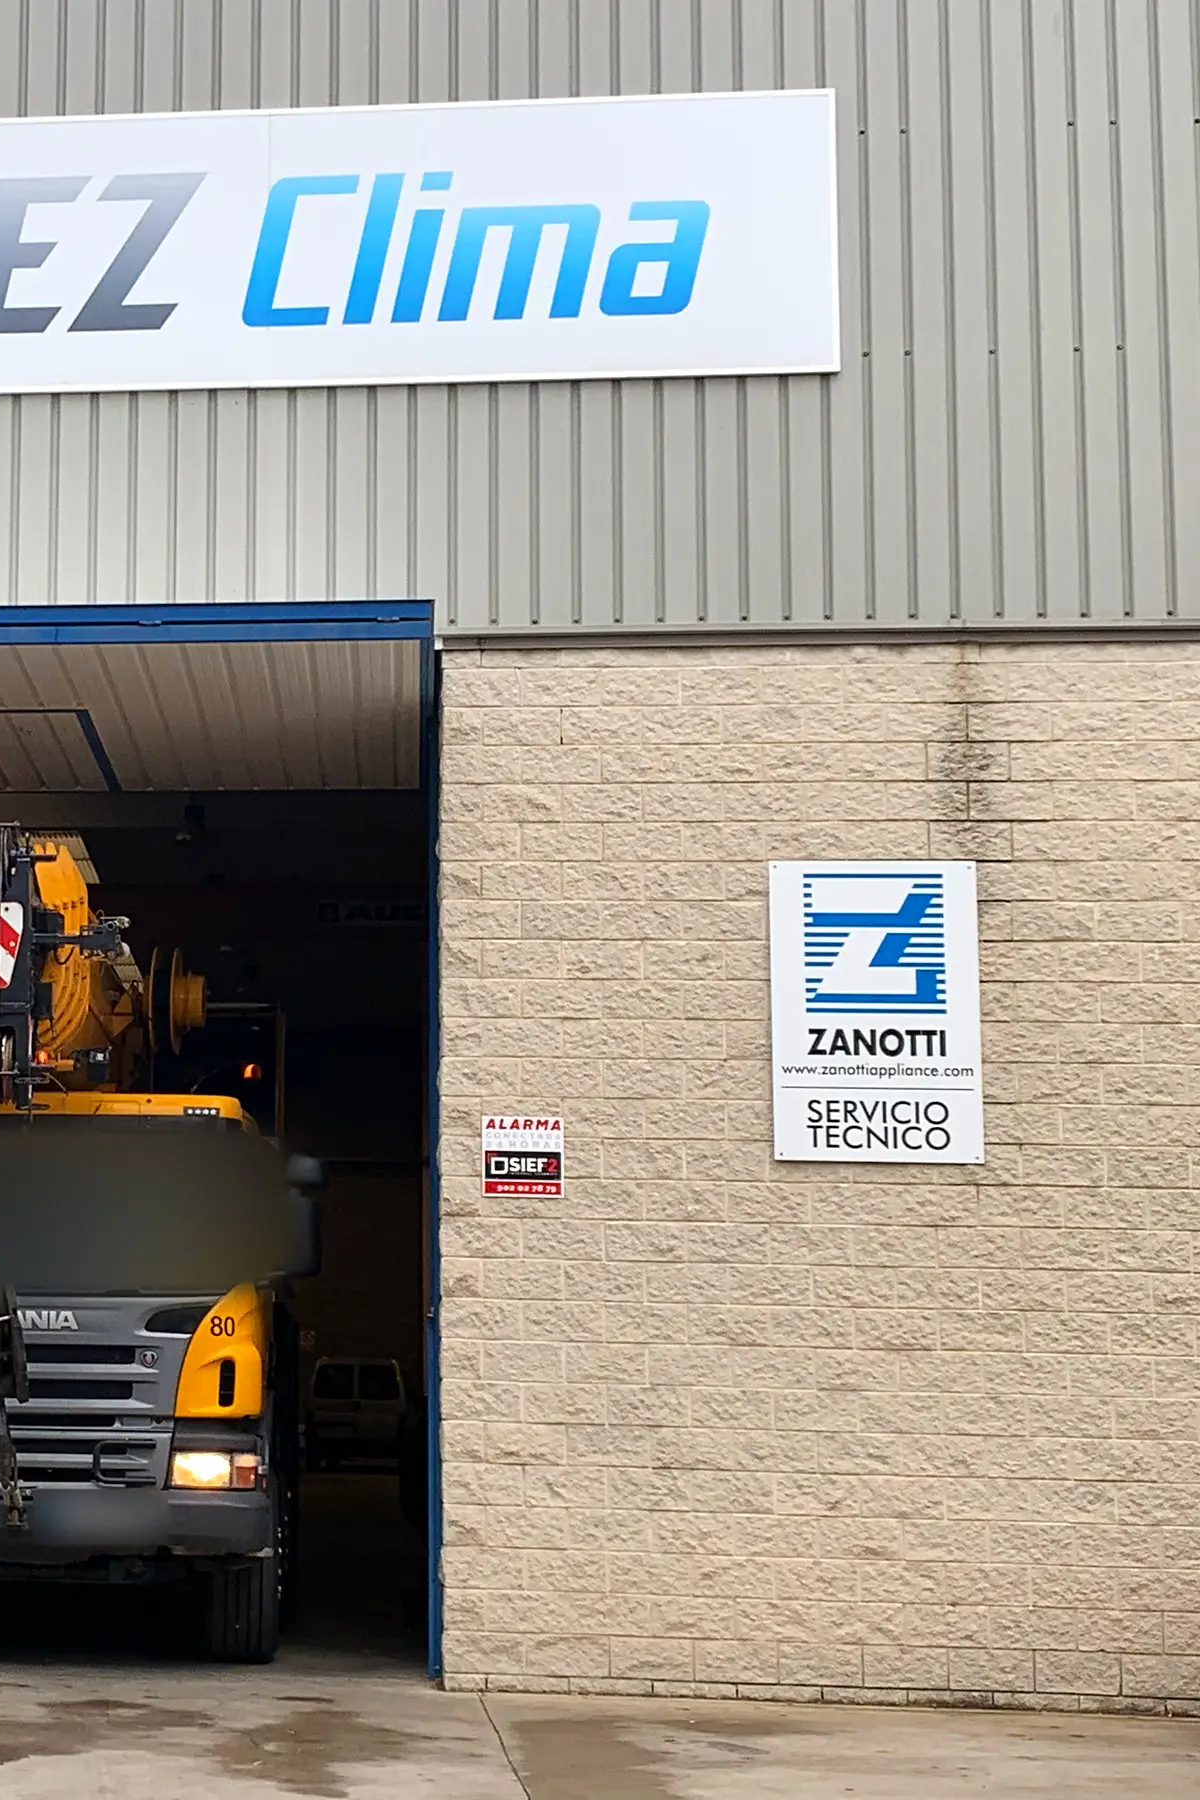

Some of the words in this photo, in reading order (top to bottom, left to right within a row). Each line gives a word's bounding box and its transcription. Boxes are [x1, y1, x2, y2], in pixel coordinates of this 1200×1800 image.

[241, 170, 710, 328] Clima
[807, 1028, 947, 1057] ZANOTTI
[781, 1062, 974, 1079] www.zanottiappliance.com
[485, 1118, 561, 1131] ALARMA
[807, 1099, 949, 1125] SERVICIO
[806, 1125, 951, 1151] TECNICO
[210, 1315, 235, 1337] 80
